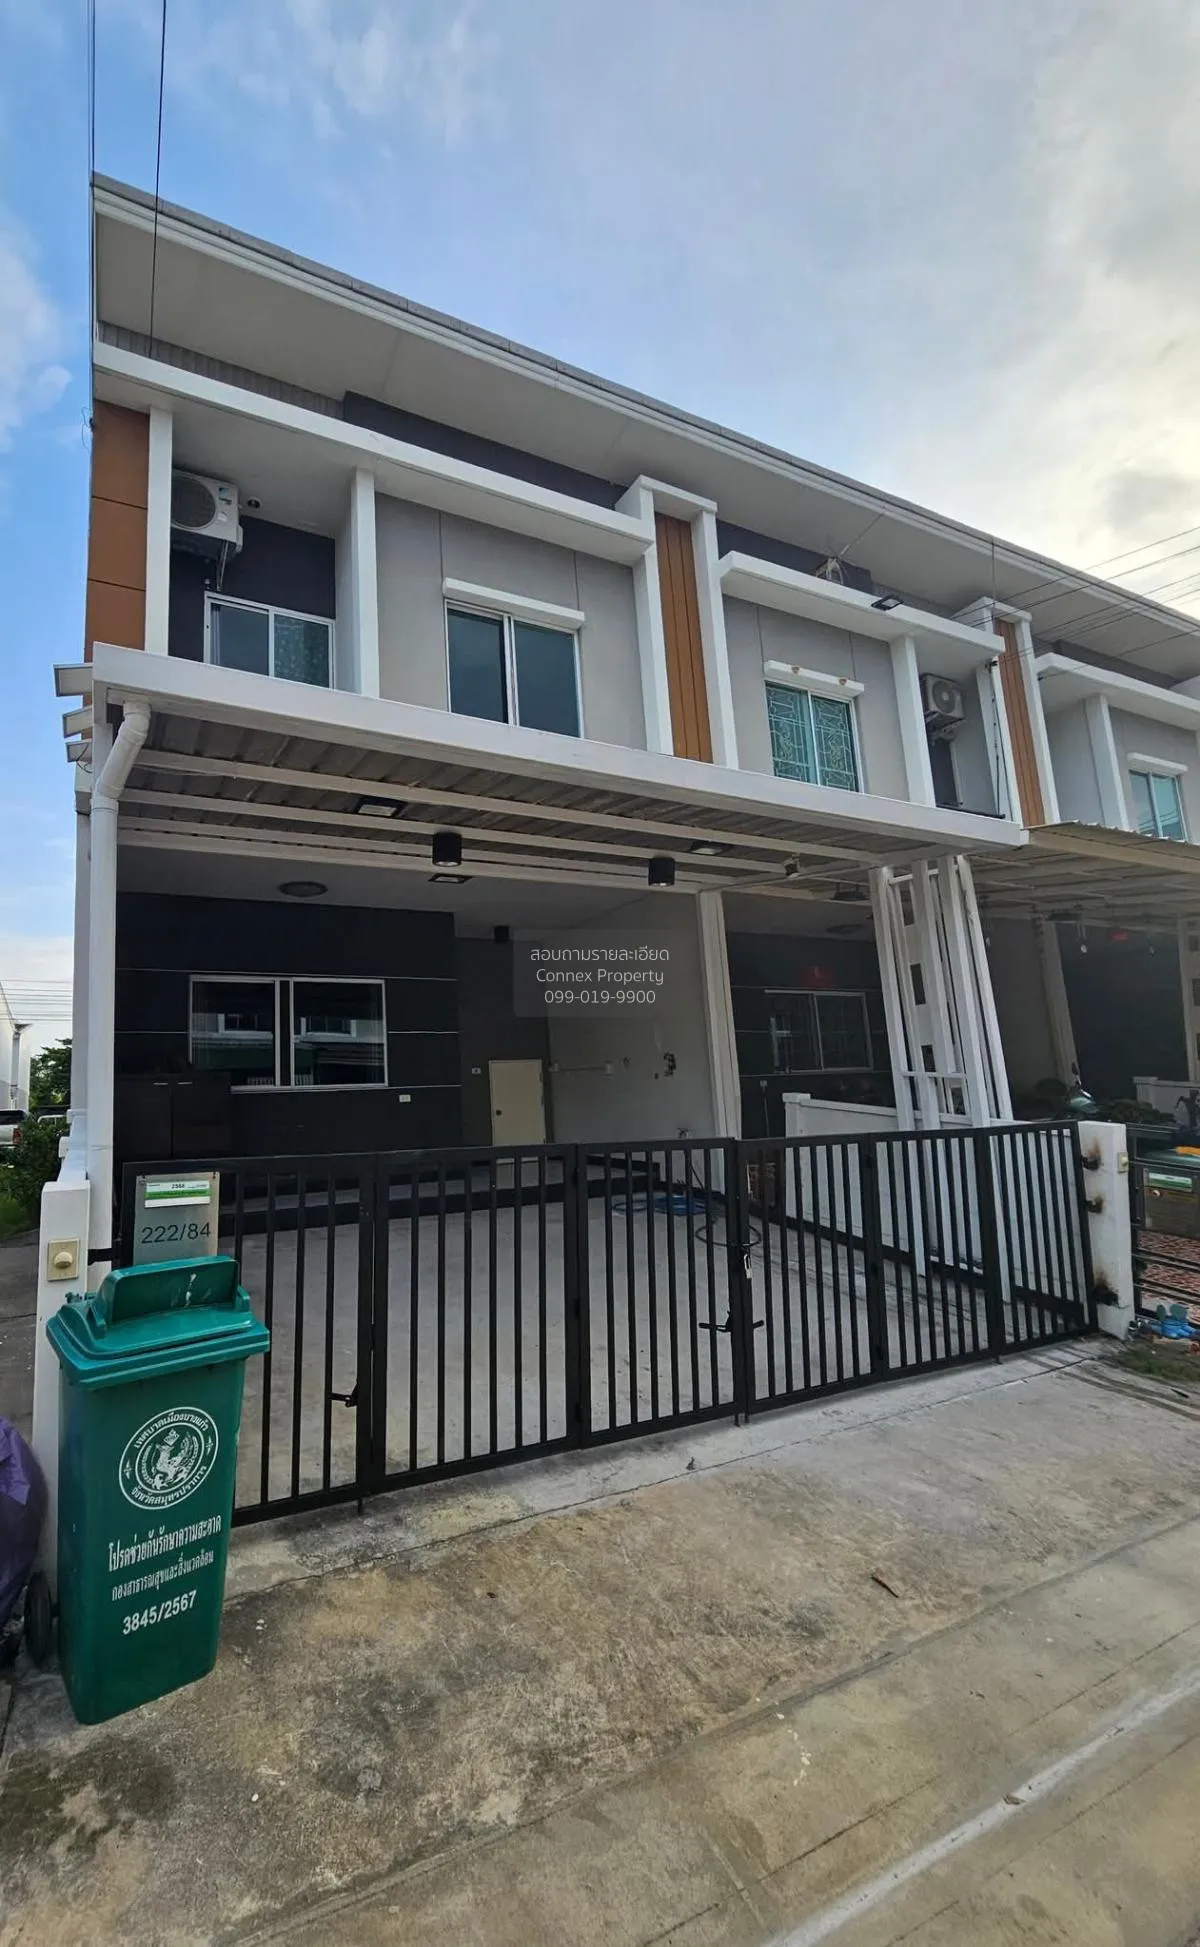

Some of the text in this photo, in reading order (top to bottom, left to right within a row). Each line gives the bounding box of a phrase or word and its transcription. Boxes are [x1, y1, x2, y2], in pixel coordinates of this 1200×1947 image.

[141, 1222, 211, 1244] 222/84
[108, 1515, 222, 1573] โปรดช่วยกันรักษาความสะอาด
[111, 1548, 214, 1601] กองสาธารณสุขและสิ่งแวดล้อม
[122, 1589, 198, 1635] 3845/2567
